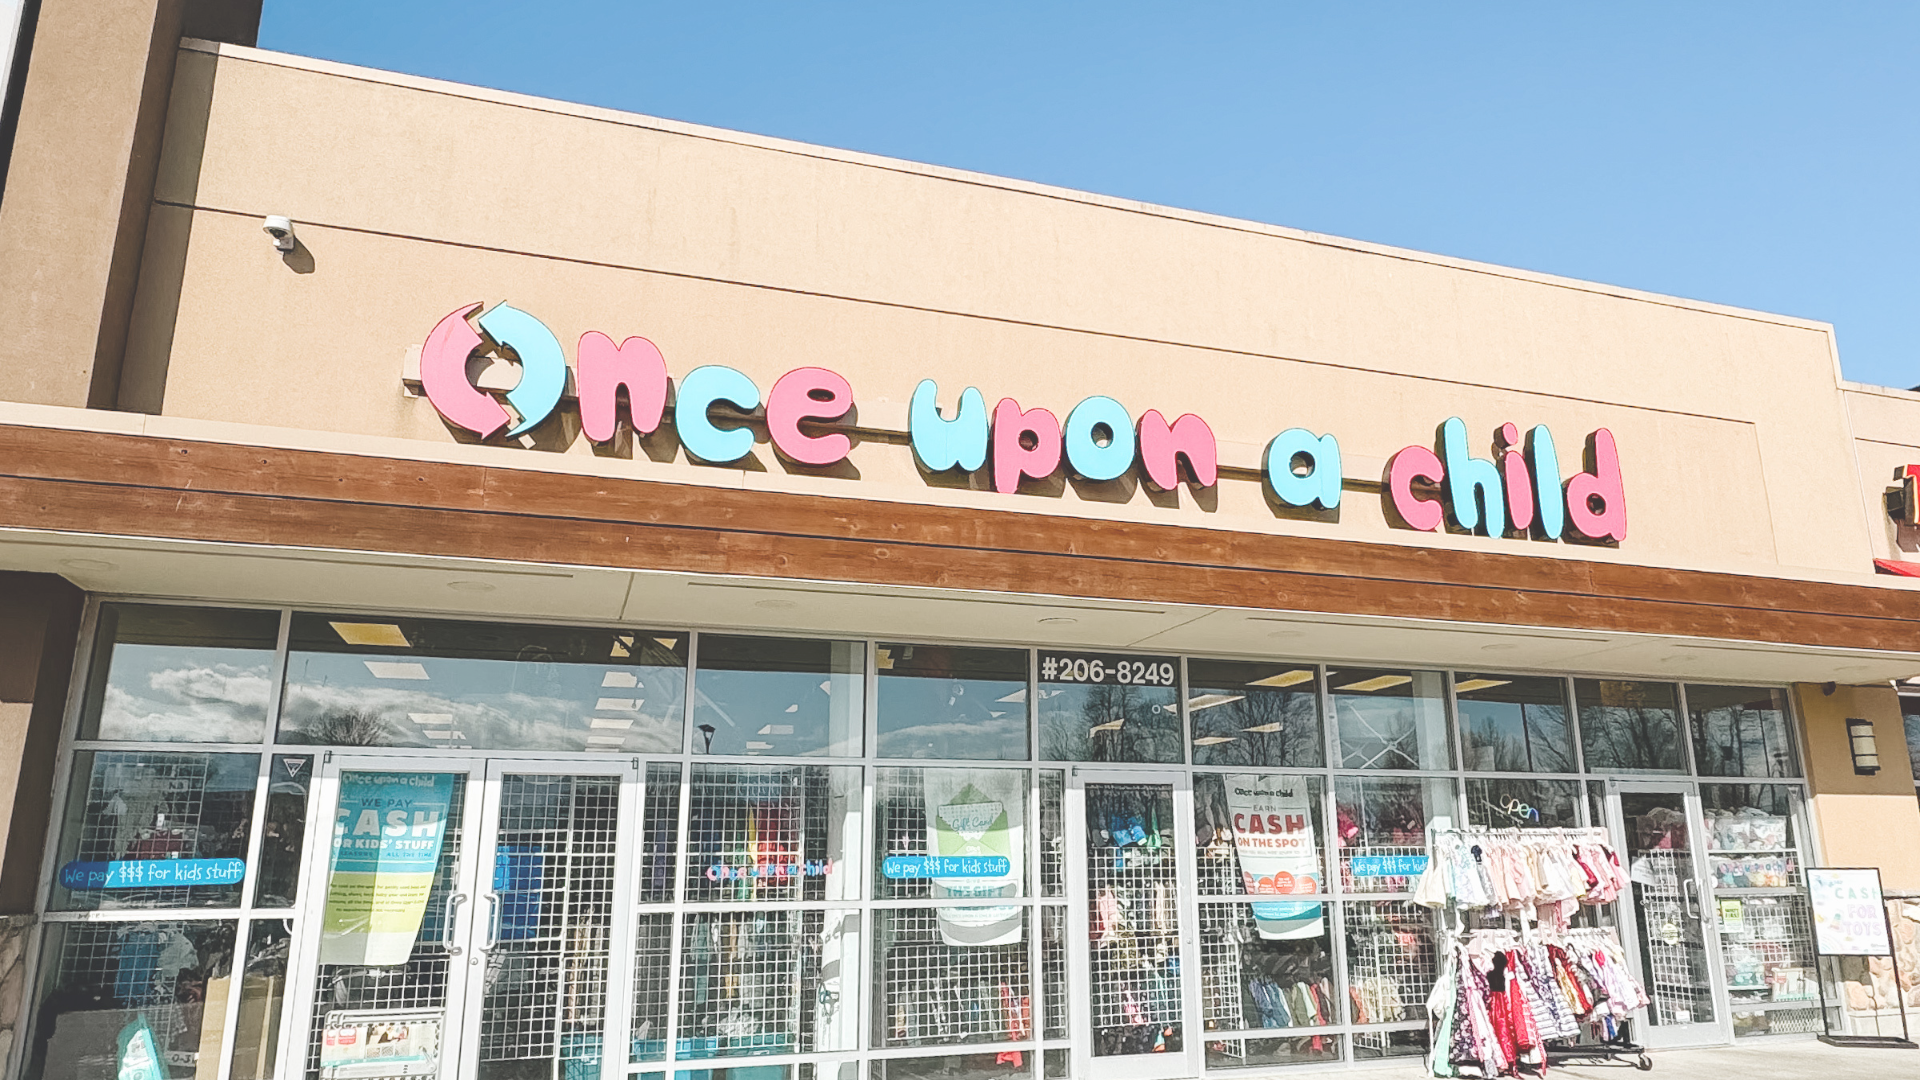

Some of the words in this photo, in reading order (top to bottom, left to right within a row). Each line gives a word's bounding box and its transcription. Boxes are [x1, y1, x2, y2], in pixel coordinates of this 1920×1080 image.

[420, 299, 854, 465] Once
[909, 379, 1218, 494] upon
[1267, 427, 1343, 510] a
[1389, 416, 1627, 542] child
[1041, 656, 1174, 685] #206-8249
[400, 776, 408, 784] a
[361, 799, 382, 807] WE
[387, 799, 413, 807] PAY
[335, 808, 440, 837] CASH
[952, 817, 971, 831] Gift
[1234, 813, 1305, 834] CASH
[333, 839, 352, 849] OR
[355, 839, 393, 849] KIDS'
[395, 840, 435, 850] STUFF
[1238, 837, 1250, 847] ON
[1252, 838, 1273, 847] THE
[1275, 838, 1306, 847] SPOT
[65, 869, 84, 883] We
[88, 870, 115, 887] pay
[119, 860, 144, 883] $$$
[148, 864, 171, 881] for
[175, 863, 202, 881] kids
[205, 861, 242, 880] stuff
[799, 857, 833, 877] child
[886, 861, 900, 874] We
[903, 864, 922, 877] pay
[923, 857, 941, 875] $$$
[944, 859, 959, 874] for
[962, 858, 982, 874] kids
[983, 858, 1008, 873] stuff
[1367, 863, 1381, 876] pay
[1382, 856, 1397, 873] $$$
[1398, 859, 1411, 872] for
[1847, 904, 1878, 918] FOR
[1842, 920, 1882, 936] TOYS
[172, 1053, 195, 1064] 0-3
